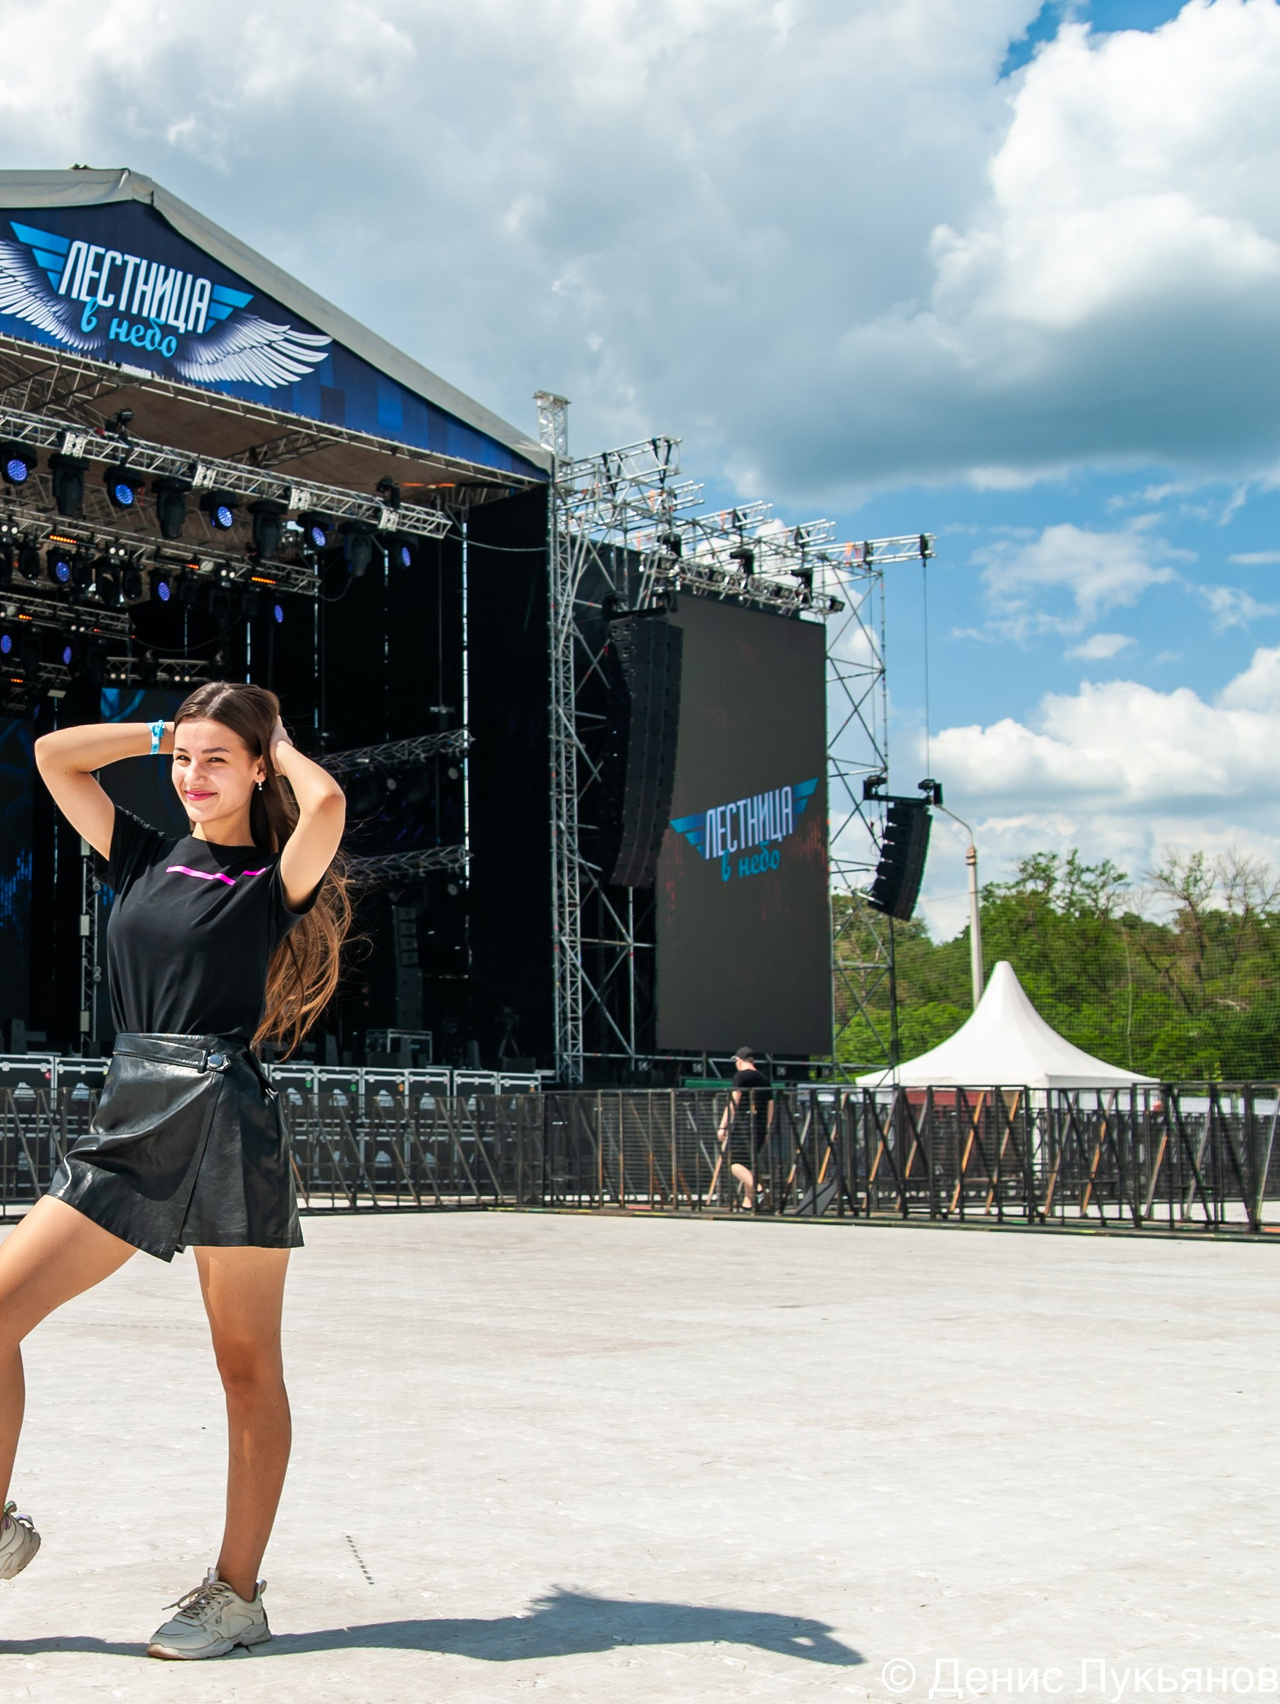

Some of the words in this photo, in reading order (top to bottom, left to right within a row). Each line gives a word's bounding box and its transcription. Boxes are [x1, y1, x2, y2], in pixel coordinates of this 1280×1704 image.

[58, 240, 212, 334] ЛЕСТНИЦА
[81, 297, 98, 333] в
[109, 316, 178, 358] небо
[705, 786, 793, 860] ЛЕСТНИЦА
[721, 850, 732, 882] в
[738, 841, 780, 878] небо
